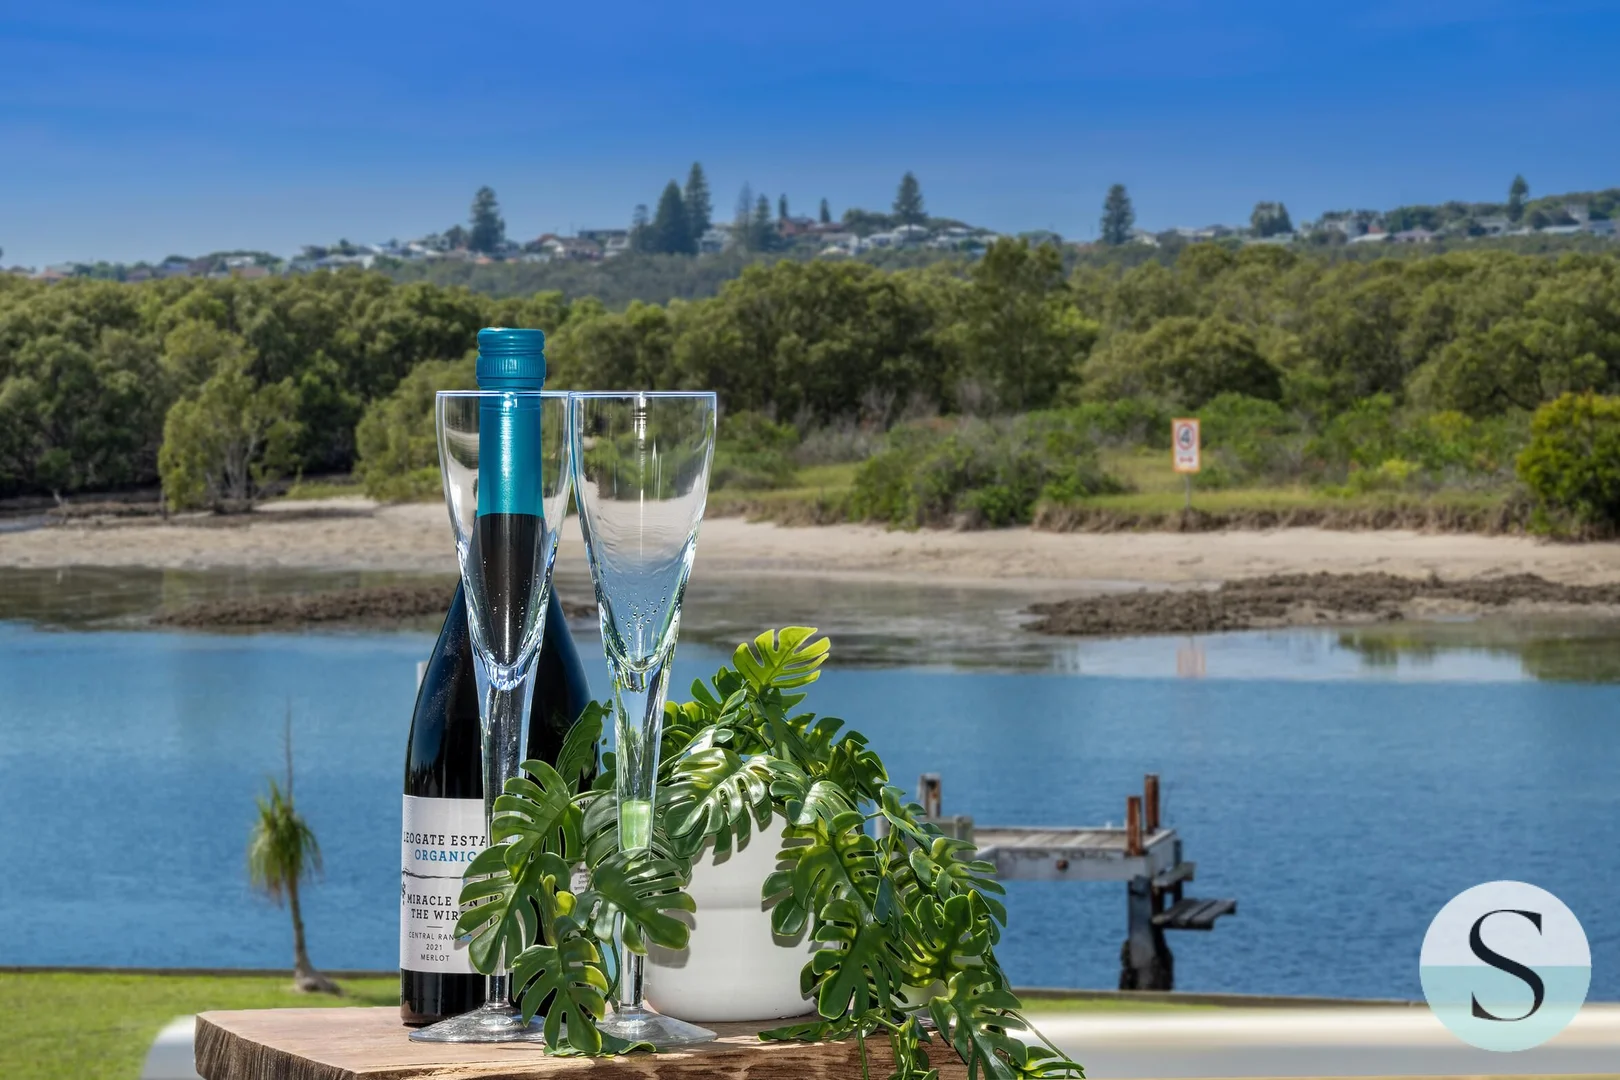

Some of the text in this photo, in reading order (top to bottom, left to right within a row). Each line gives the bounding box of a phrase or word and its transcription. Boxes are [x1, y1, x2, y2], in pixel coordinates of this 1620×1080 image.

[1181, 429, 1190, 443] 4
[414, 849, 477, 862] ORGANIC
[407, 894, 452, 906] MIRACLE
[411, 908, 464, 921] THE WIR
[408, 931, 458, 941] CENTRAL RAN
[426, 943, 443, 951] 2021
[420, 953, 450, 962] MERLOT
